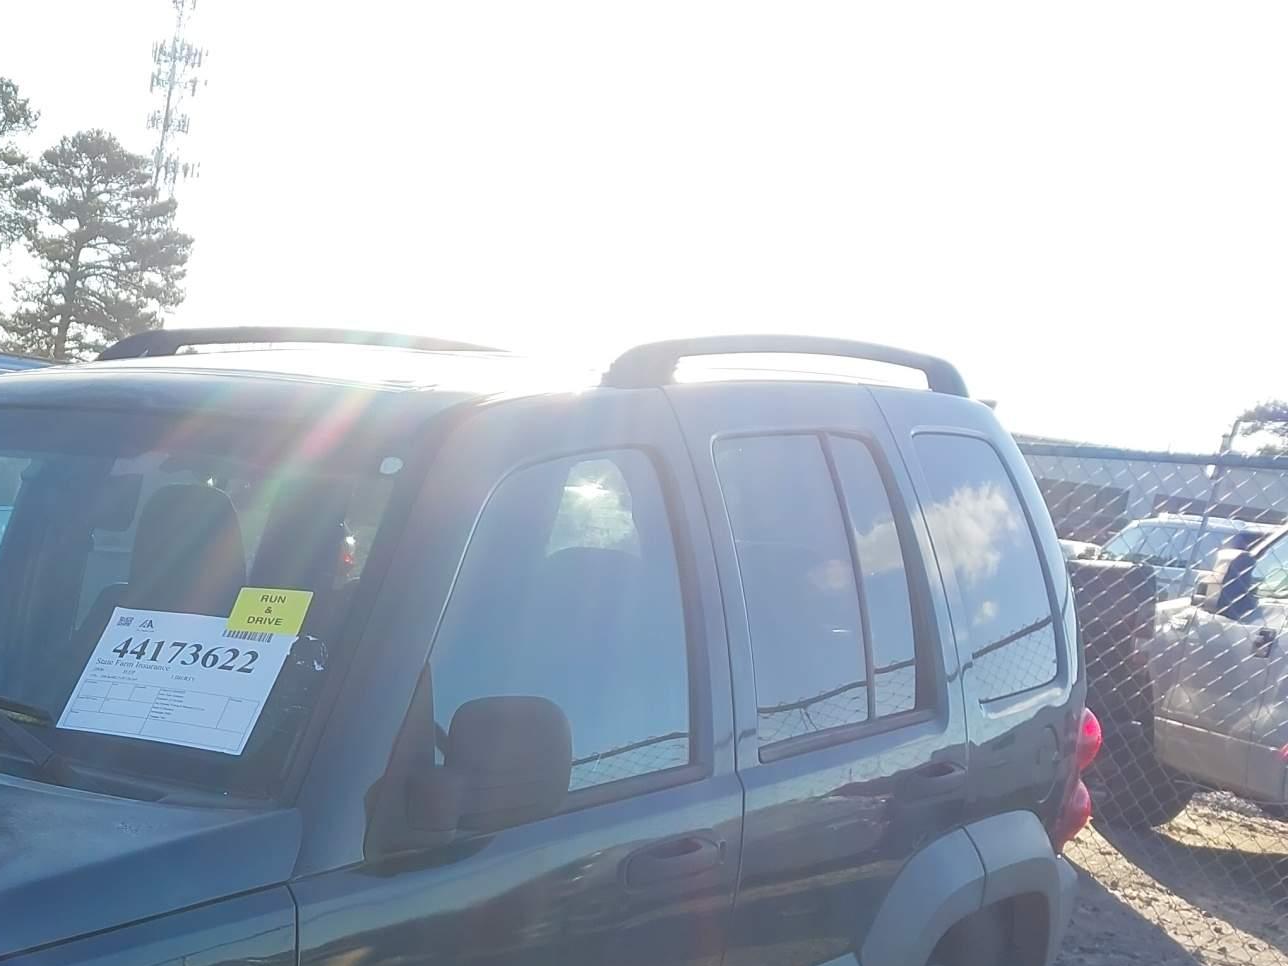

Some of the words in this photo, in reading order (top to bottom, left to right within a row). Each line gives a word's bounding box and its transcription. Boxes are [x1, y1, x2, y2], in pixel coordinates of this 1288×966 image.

[260, 594, 287, 605] RUN
[264, 606, 273, 615] &
[247, 615, 284, 627] DRIVE
[112, 636, 260, 675] 44173622
[114, 659, 134, 668] Farm
[134, 661, 172, 672] Insurance
